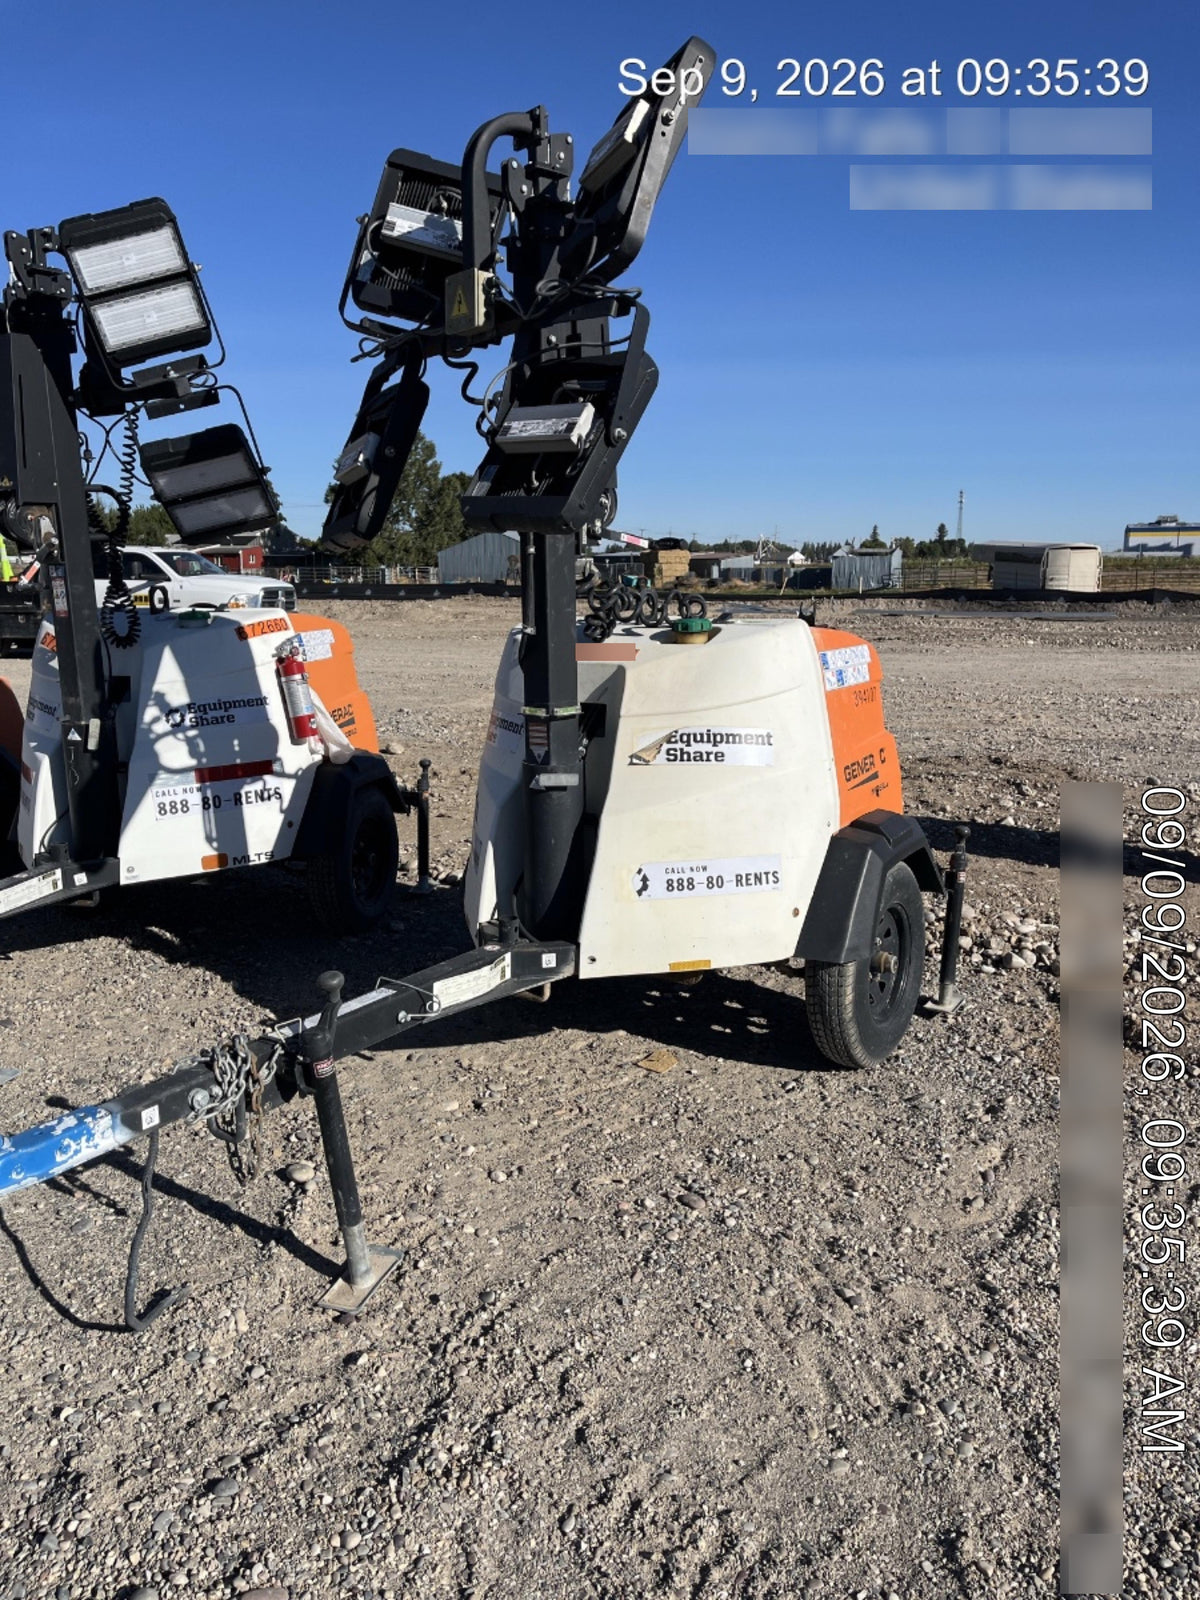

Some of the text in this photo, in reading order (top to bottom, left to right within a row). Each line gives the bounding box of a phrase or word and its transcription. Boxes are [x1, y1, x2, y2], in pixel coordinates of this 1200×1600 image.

[235, 617, 290, 641] 672660
[187, 695, 269, 715] Equipment
[190, 714, 235, 728] Share
[666, 729, 773, 747] Equipment
[666, 747, 725, 763] Share
[155, 785, 202, 798] CALL NOW
[232, 851, 275, 866] MLTS
[665, 865, 708, 875] CALL NOW
[666, 870, 780, 892] 888-80-RENTS
